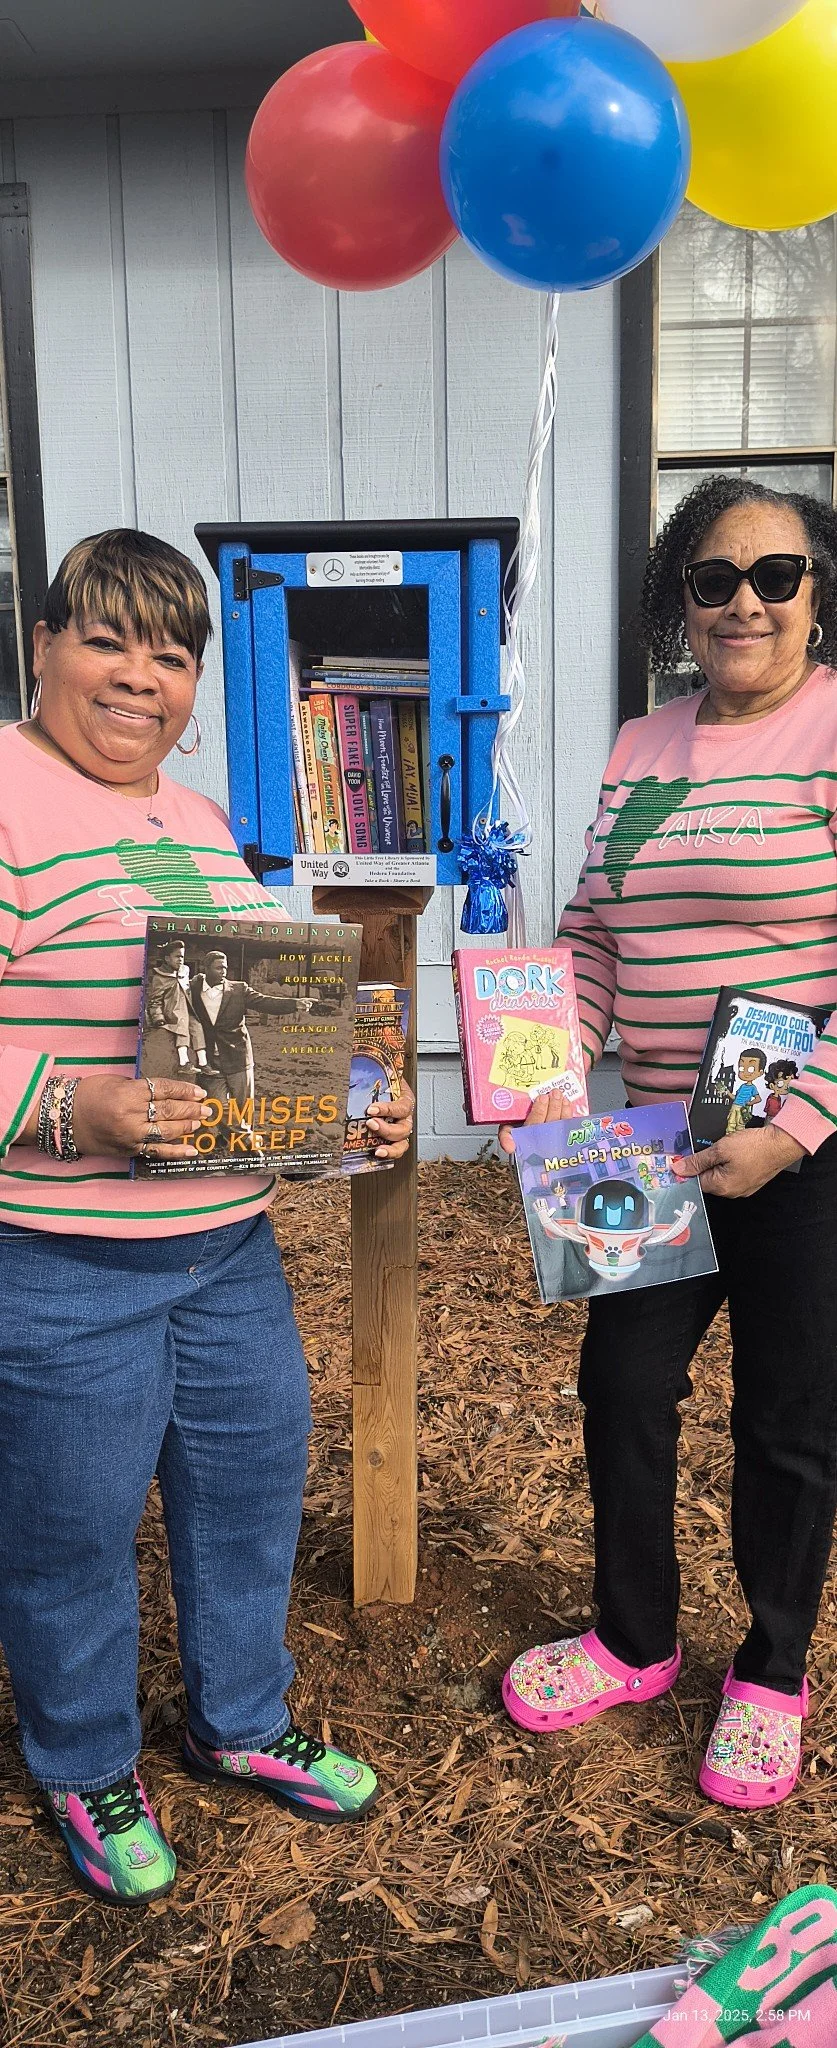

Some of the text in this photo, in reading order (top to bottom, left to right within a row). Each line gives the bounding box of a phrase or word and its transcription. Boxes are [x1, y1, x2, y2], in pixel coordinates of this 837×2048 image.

[326, 683, 371, 691] CORDUROY'S
[343, 704, 359, 766] SUPER FAKE
[310, 782, 318, 800] PET
[322, 764, 336, 815] LAST CHANCE
[381, 790, 392, 805] Love
[352, 793, 368, 848] LOVE SONG
[658, 806, 766, 850] AKA
[300, 860, 329, 869] United
[312, 869, 329, 880] Way
[152, 922, 358, 938] SHARON ROBINSON
[312, 955, 353, 963] JACKIE
[284, 976, 344, 984] ROBINSON
[475, 964, 565, 999] DORK
[490, 988, 558, 1011] diaries
[745, 1007, 809, 1032] DESMOND COLE
[730, 1017, 815, 1053] GHOST PATROL
[281, 1046, 335, 1054] AMERICA
[200, 1095, 338, 1127] OMISES
[229, 1129, 306, 1152] KEEP
[343, 1139, 366, 1149] AMES
[544, 1154, 585, 1172] Meet
[588, 1148, 608, 1163] PJ
